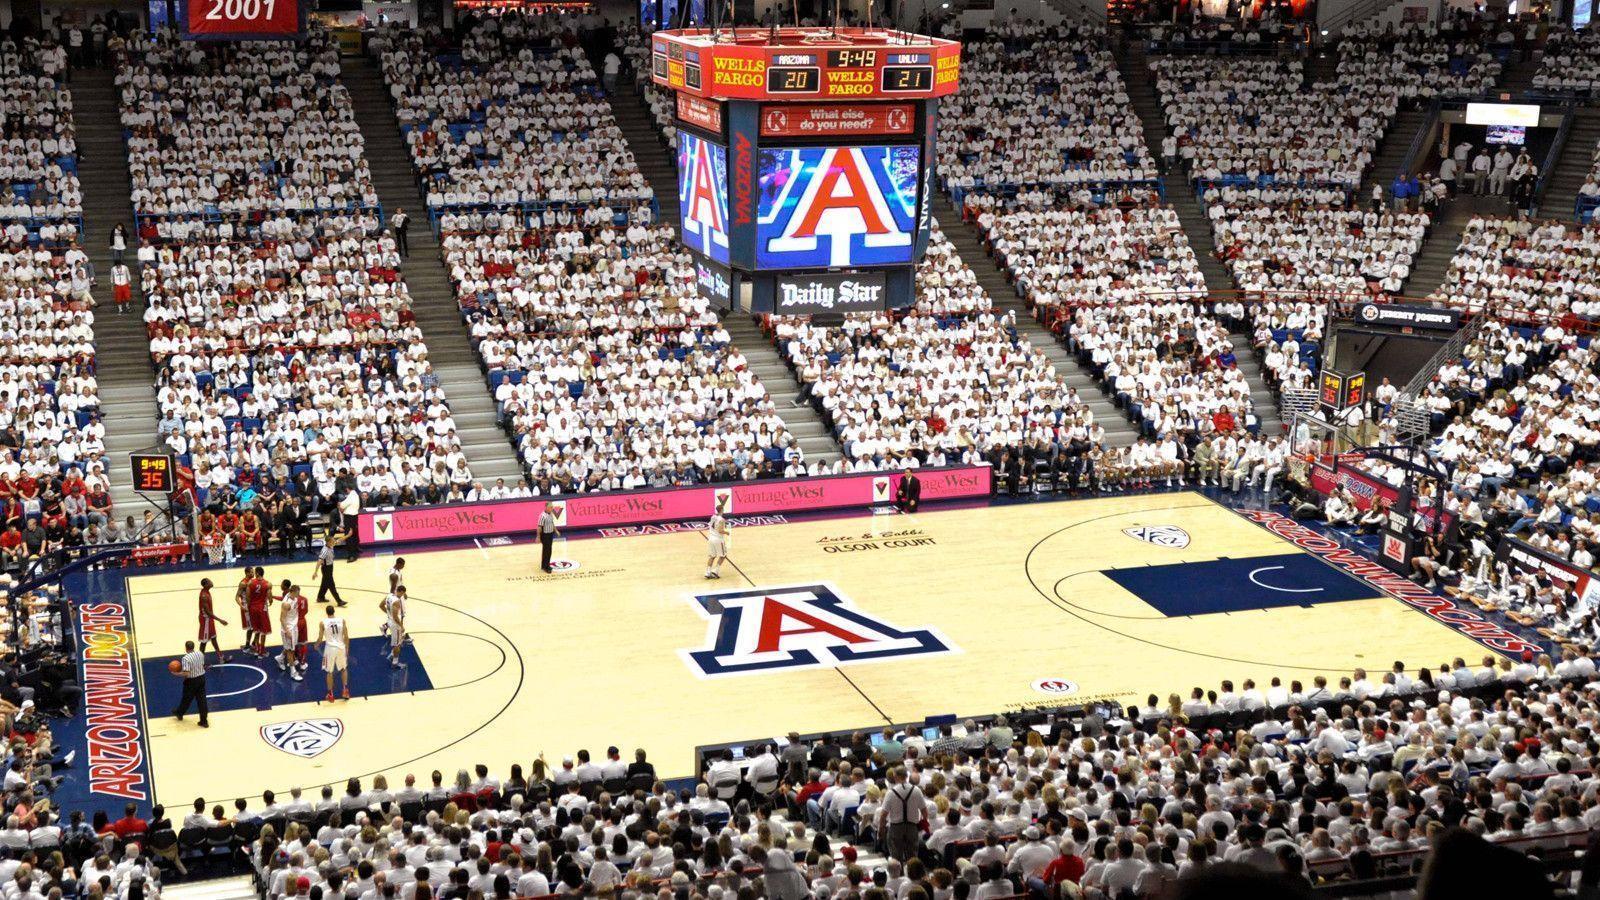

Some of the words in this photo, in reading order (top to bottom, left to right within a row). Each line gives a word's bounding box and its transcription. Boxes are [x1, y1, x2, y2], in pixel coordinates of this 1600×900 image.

[206, 0, 275, 20] 2001
[713, 57, 765, 71] WELLS
[778, 55, 810, 65] ARIZONA
[838, 50, 876, 67] 9:49
[937, 54, 959, 69] WELLS
[713, 71, 764, 87] FARGO
[784, 71, 806, 89] 20
[826, 71, 875, 82] WELLS
[898, 70, 921, 87] 21
[936, 69, 958, 85] FARGO
[828, 83, 874, 95] FARGO
[810, 109, 838, 119] What
[841, 109, 865, 119] else
[800, 120, 816, 130] do
[817, 121, 841, 131] you
[842, 119, 874, 130] need?
[735, 131, 750, 226] ARIZONA
[781, 282, 835, 308] Daily
[838, 280, 882, 301] Star
[141, 459, 166, 470] 9:49
[141, 472, 162, 487] 35
[734, 486, 824, 505] VantageWest
[569, 498, 664, 517] VantageWest
[395, 511, 495, 531] VantageWest
[598, 522, 683, 538] BEAR
[823, 543, 880, 553] OLSON
[883, 538, 936, 548] COURT
[330, 624, 339, 635] 11
